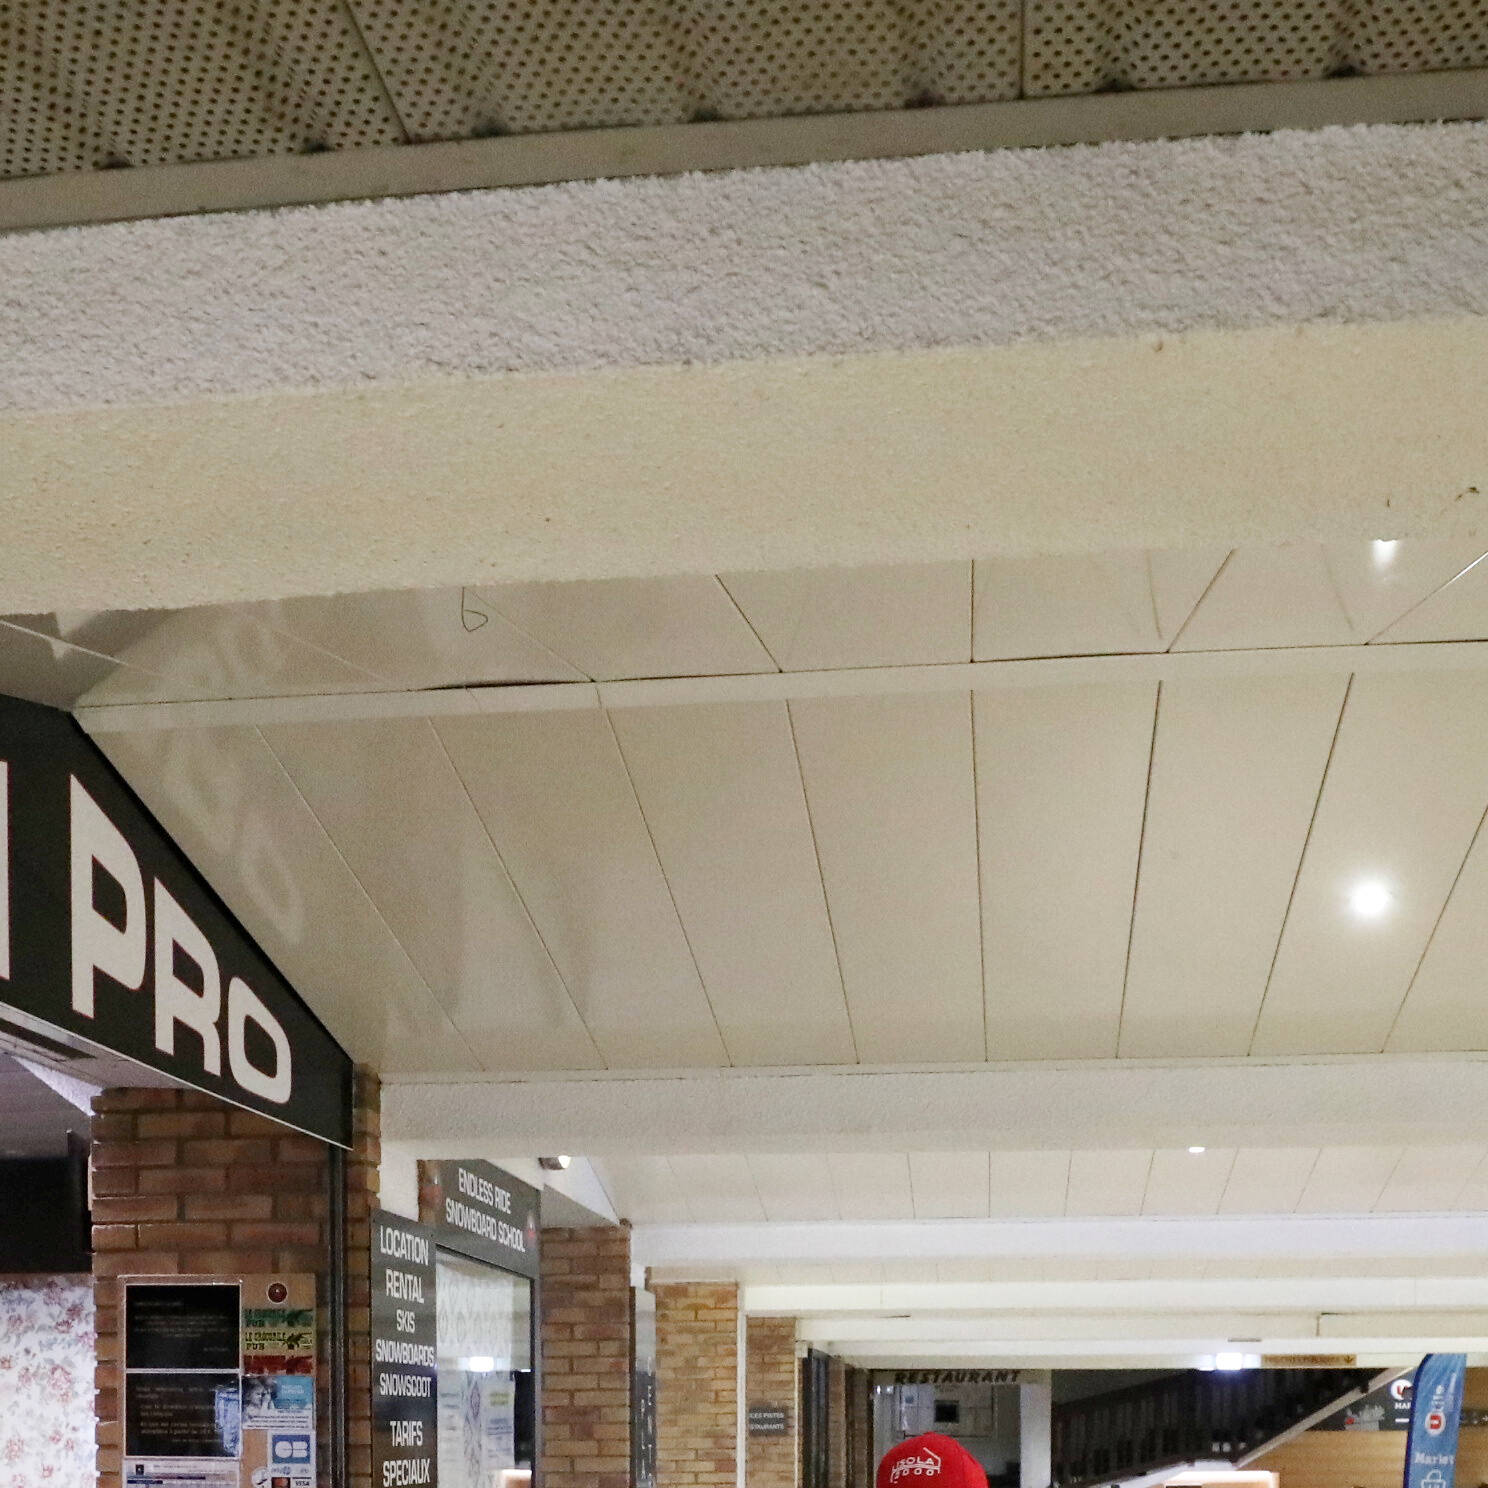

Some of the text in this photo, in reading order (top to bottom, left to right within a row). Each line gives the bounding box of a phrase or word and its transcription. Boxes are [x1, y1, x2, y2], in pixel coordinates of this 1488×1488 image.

[70, 773, 292, 1103] PRO
[458, 1168, 511, 1214] ENDLESS RIDE
[446, 1198, 525, 1252] SNOWBOARD SCHOOL
[380, 1225, 429, 1265] LOCATION
[386, 1269, 424, 1303] RENTAL
[396, 1309, 415, 1333] SKIS
[375, 1339, 435, 1367] SNOWBOARDS
[380, 1373, 432, 1397] SNOWSCOOT
[894, 1369, 1020, 1384] RESTAURANT
[390, 1420, 423, 1447] TARIFS
[383, 1458, 430, 1487] SPECIAUX
